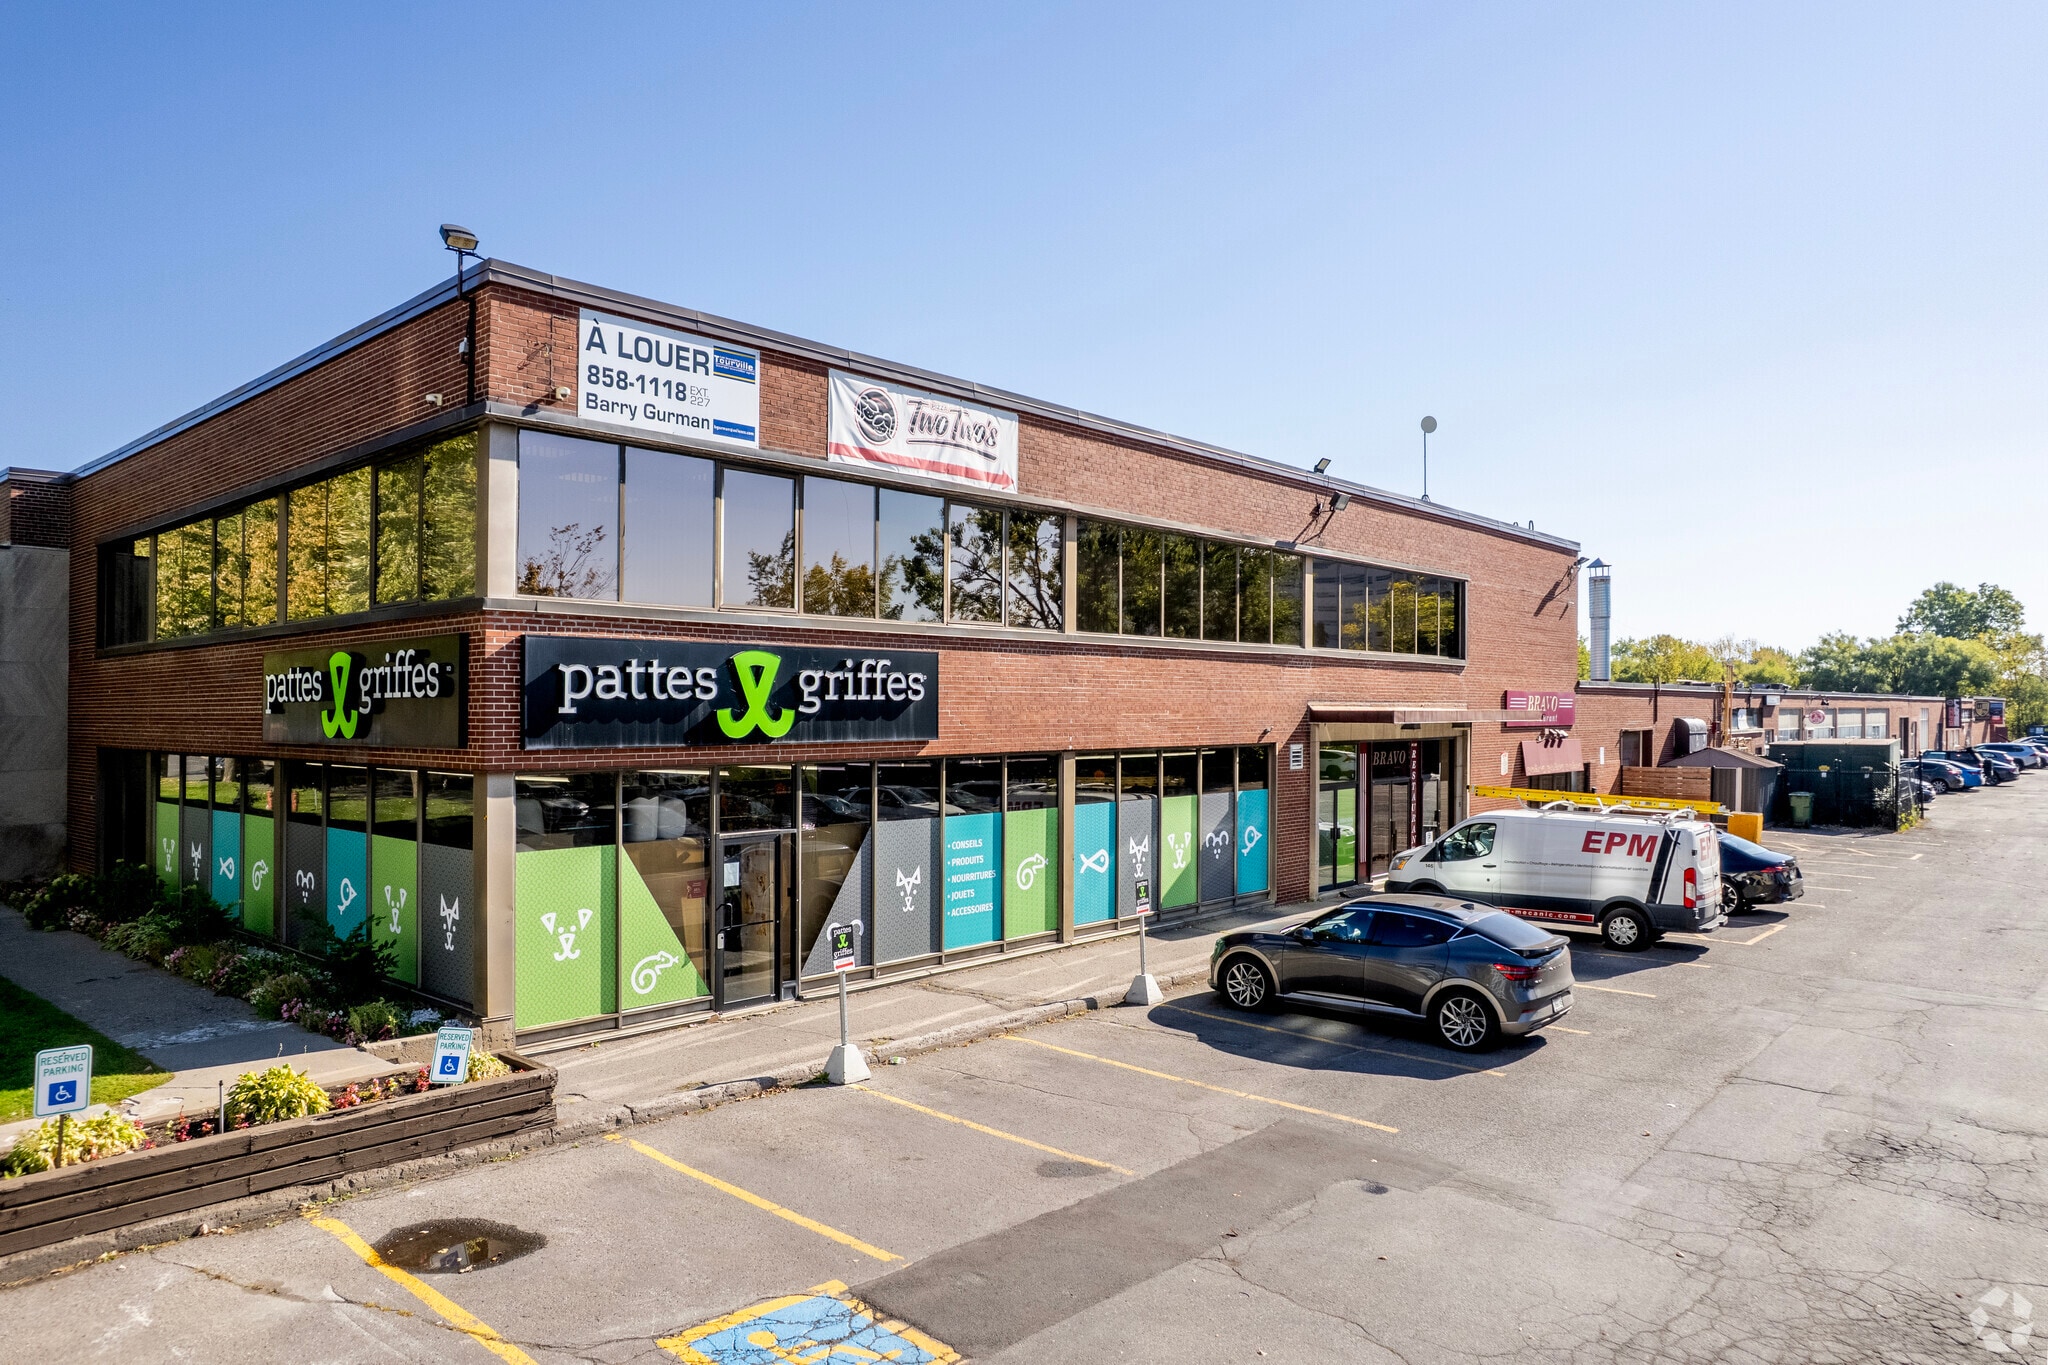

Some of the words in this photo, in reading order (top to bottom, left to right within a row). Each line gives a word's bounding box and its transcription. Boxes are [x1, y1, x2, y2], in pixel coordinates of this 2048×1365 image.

[586, 318, 607, 355] À
[618, 331, 710, 377] LOUER
[714, 355, 754, 372] Tourville
[587, 364, 687, 402] 858-1118
[690, 386, 709, 398] EXT.
[690, 396, 711, 408] 227
[586, 392, 637, 421] Barry
[643, 403, 710, 430] Gurman
[265, 667, 322, 714] pattes
[359, 649, 440, 714] griffes
[558, 658, 718, 714] pattes
[798, 658, 926, 714] griffes
[1527, 695, 1558, 712] BRAVO
[1373, 750, 1406, 766] BRAVO
[951, 839, 983, 850] CONSEILS
[1581, 830, 1659, 863] EPM
[951, 855, 984, 867] PRODUITS
[951, 870, 997, 884] NOURRITURES
[951, 889, 975, 902] JOUETS
[951, 902, 994, 917] ACCESSOIRES
[833, 948, 853, 960] griffes
[440, 1032, 469, 1042] RESERVED
[440, 1042, 466, 1051] PARKING
[41, 1052, 88, 1066] RESERVED
[43, 1063, 84, 1077] PARKING
